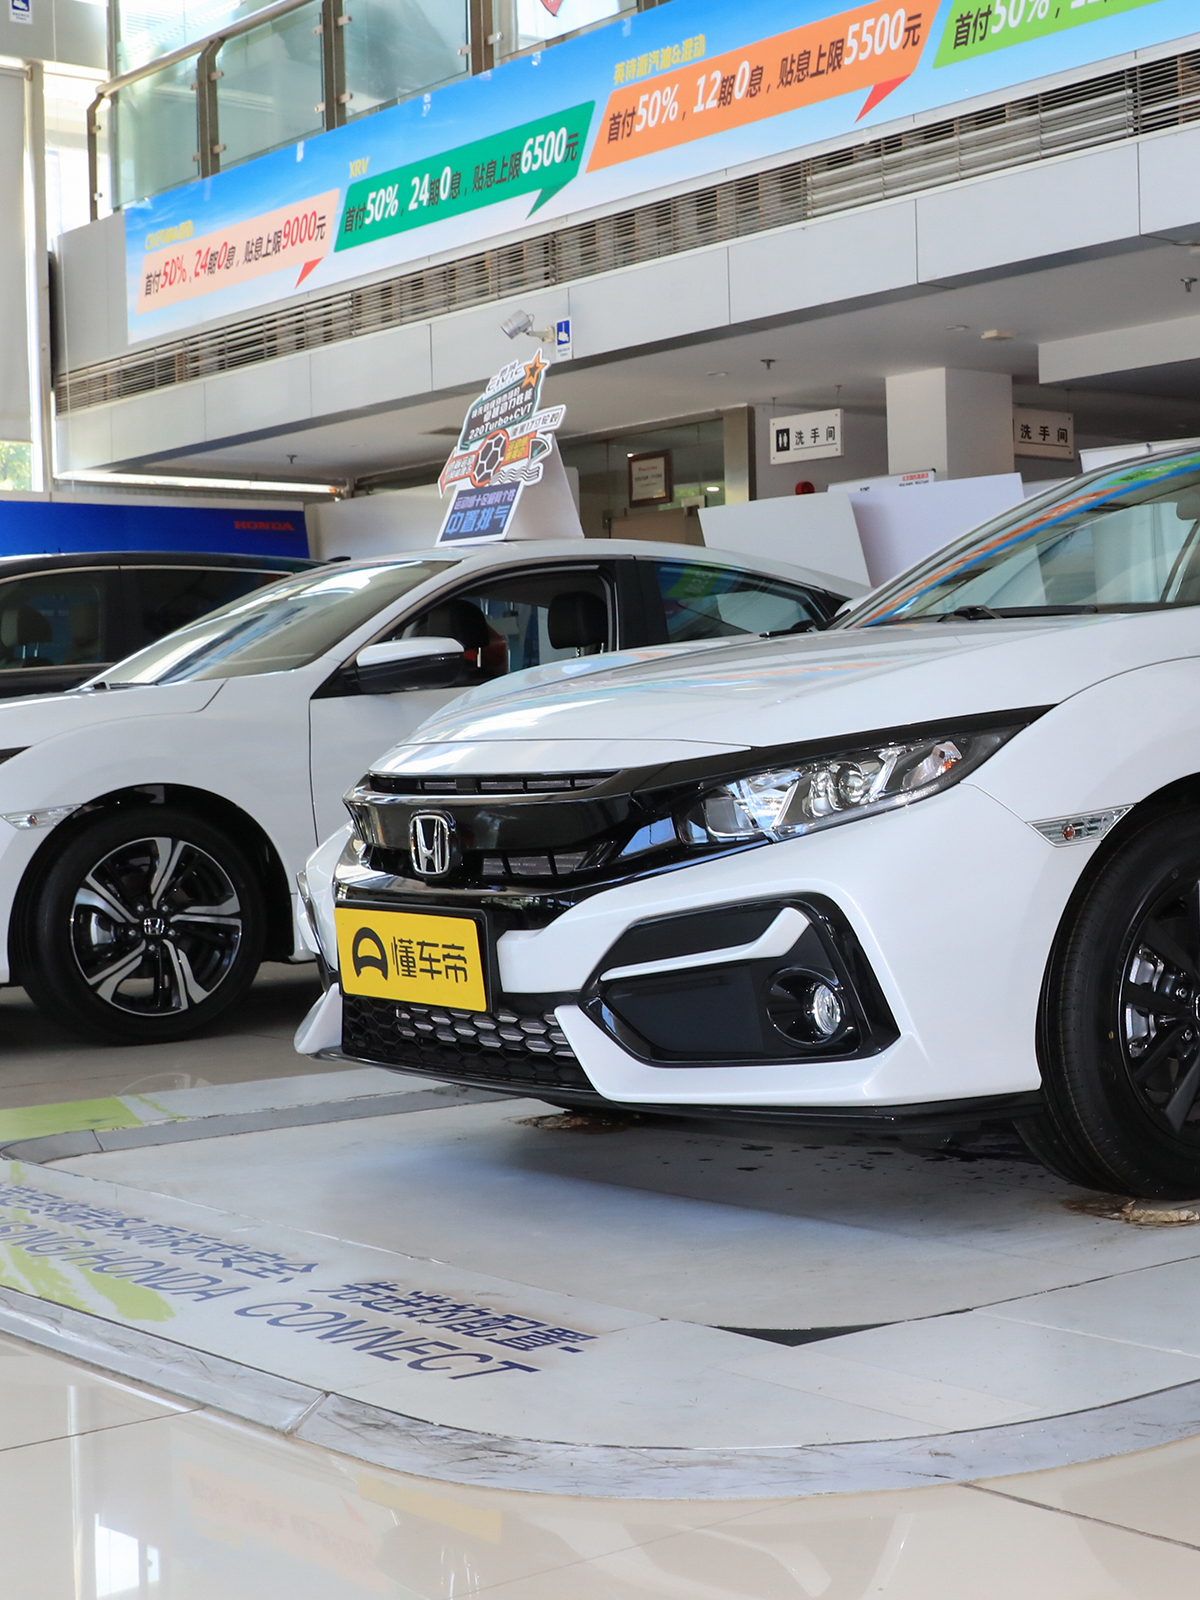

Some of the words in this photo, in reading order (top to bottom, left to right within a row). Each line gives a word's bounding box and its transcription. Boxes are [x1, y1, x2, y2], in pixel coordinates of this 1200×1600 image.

[348, 157, 370, 178] XRV
[794, 425, 836, 446] 洗手间
[1020, 422, 1069, 444] 洗手间
[234, 520, 295, 532] HONDA
[445, 504, 511, 535] 中置排气
[391, 936, 468, 984] 懂车帝
[233, 1301, 542, 1380] CONNECT
